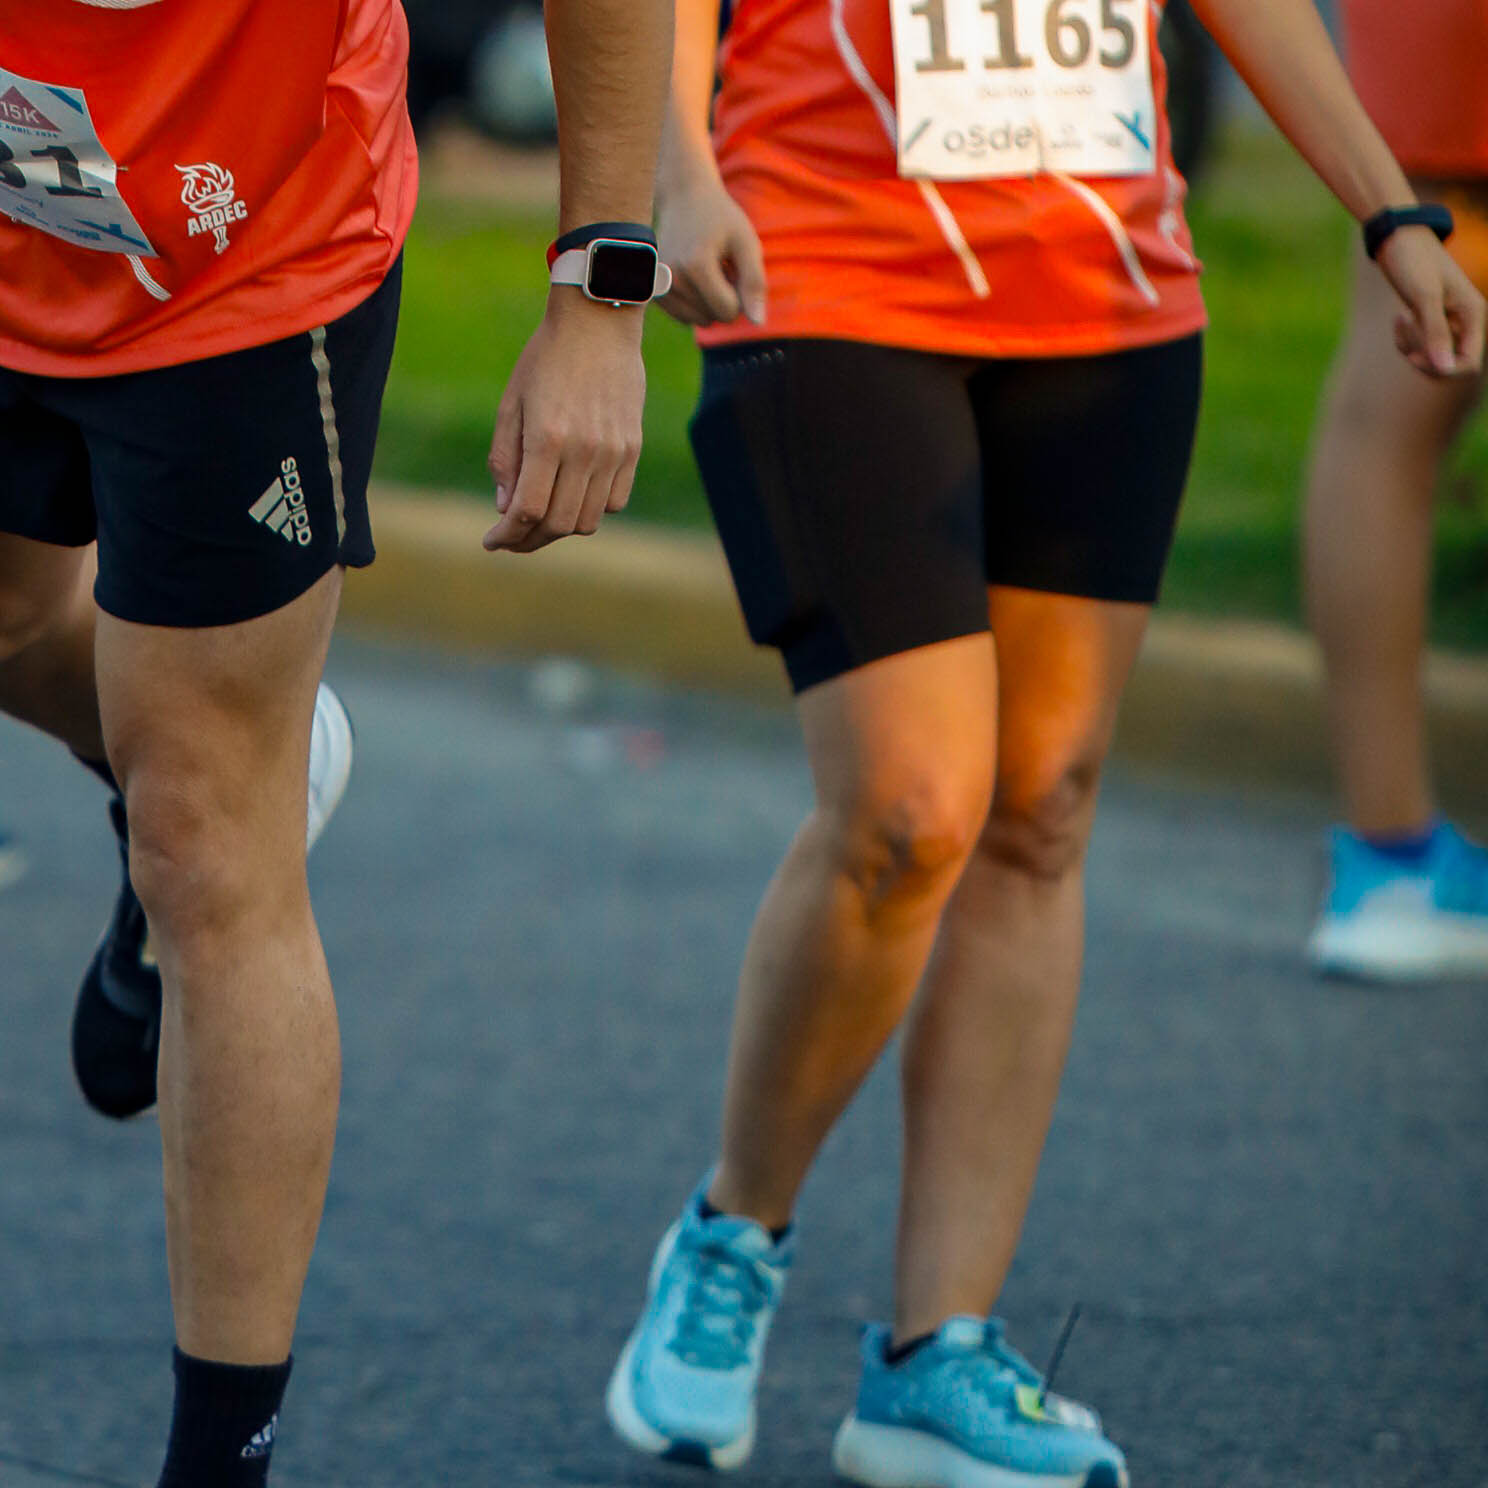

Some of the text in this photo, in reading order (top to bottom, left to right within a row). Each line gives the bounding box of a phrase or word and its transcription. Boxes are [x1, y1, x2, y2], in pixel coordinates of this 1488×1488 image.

[0, 101, 39, 124] 15K
[943, 118, 1033, 153] osde
[187, 200, 248, 237] ARDEC
[281, 456, 312, 546] adidas
